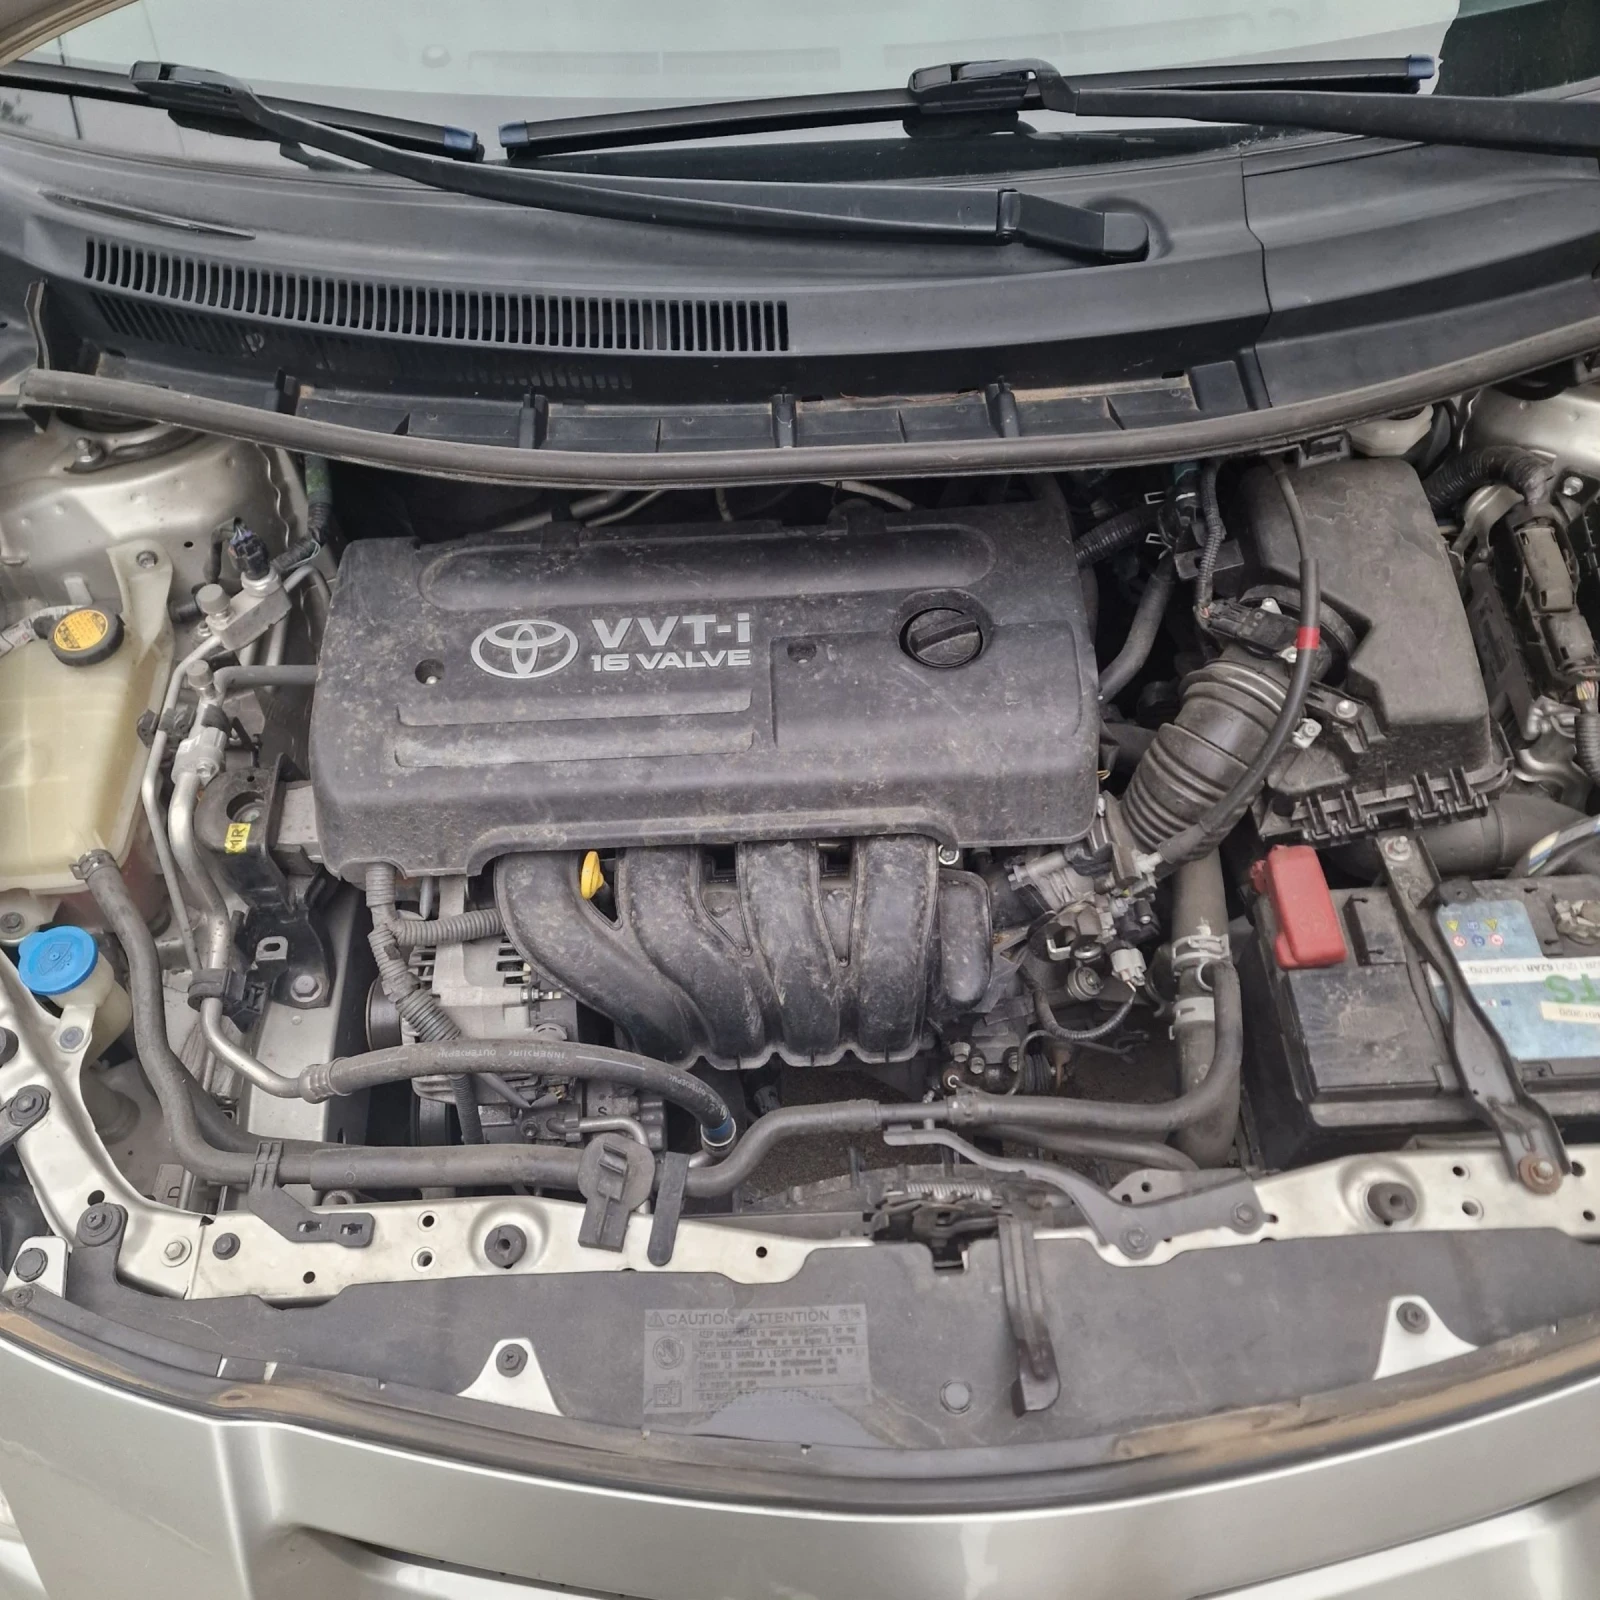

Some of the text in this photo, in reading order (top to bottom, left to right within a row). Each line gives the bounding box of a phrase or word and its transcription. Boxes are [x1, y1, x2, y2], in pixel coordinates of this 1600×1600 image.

[591, 612, 752, 649] VVT-i
[591, 649, 752, 672] 16 VALVE
[666, 1312, 735, 1326] CAUTION
[747, 1308, 830, 1324] ATTENTION
